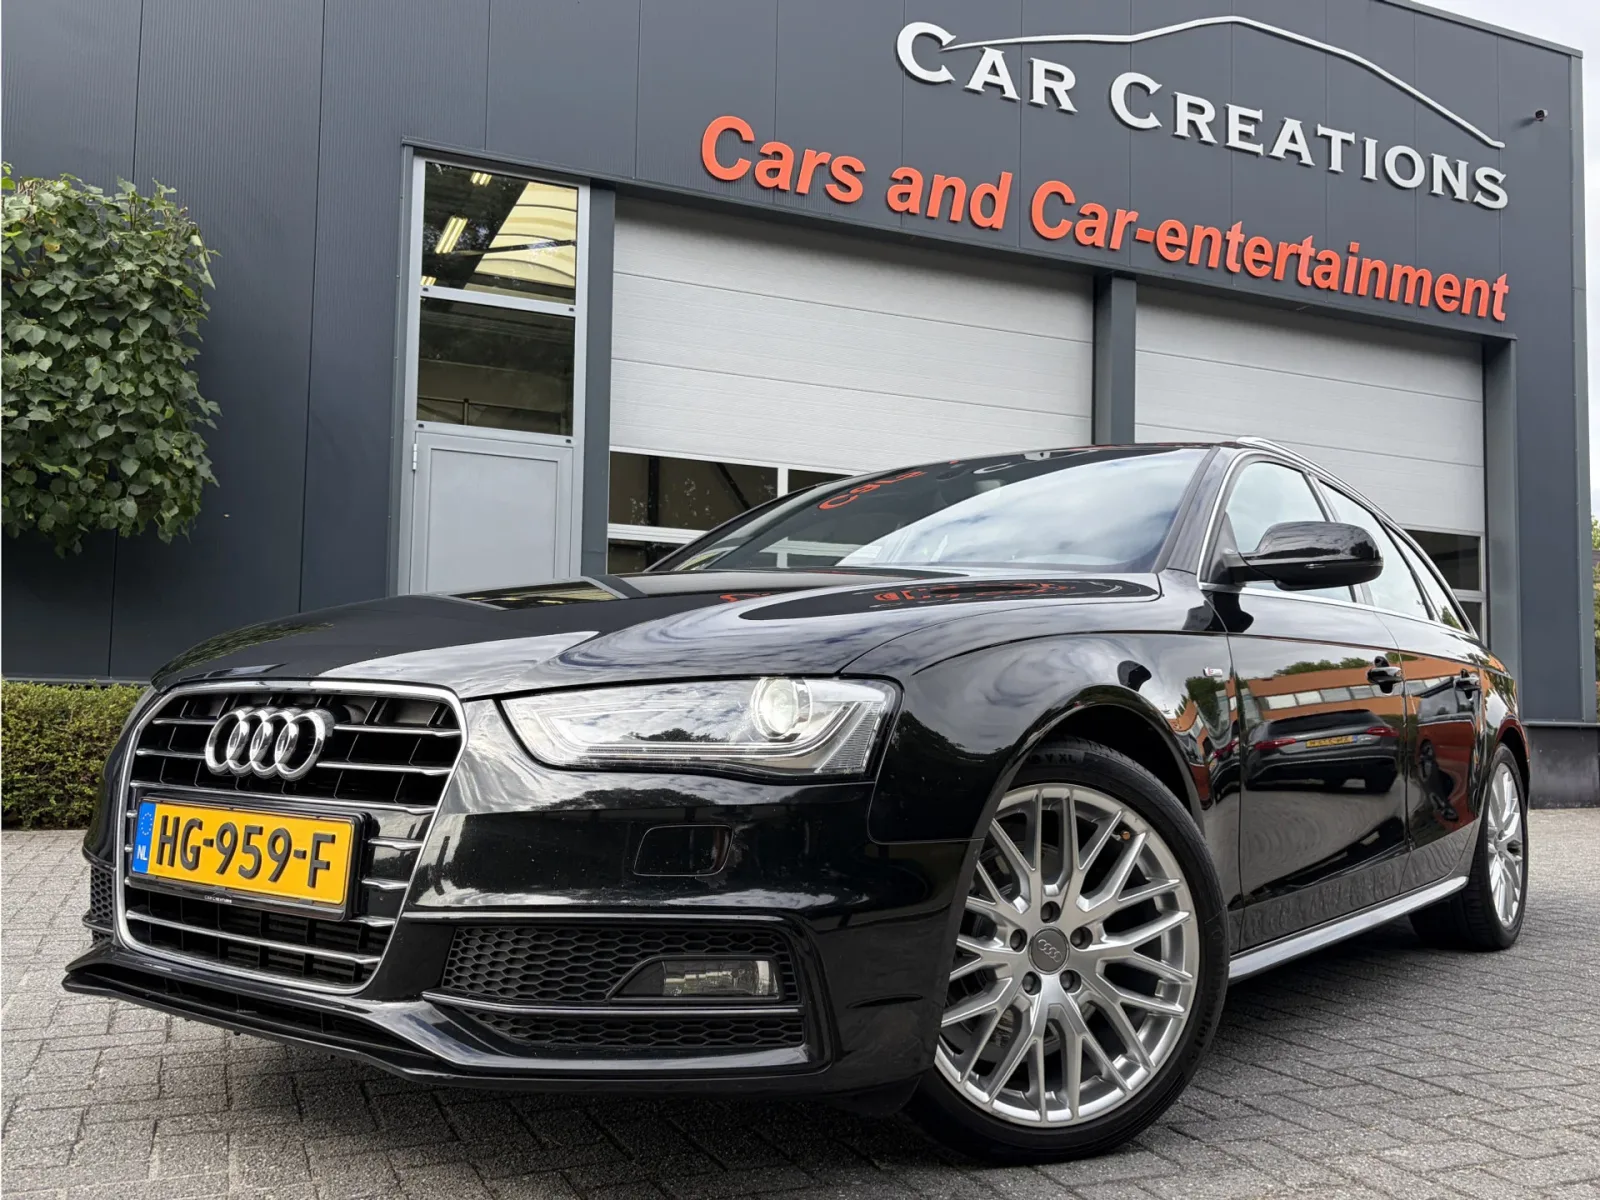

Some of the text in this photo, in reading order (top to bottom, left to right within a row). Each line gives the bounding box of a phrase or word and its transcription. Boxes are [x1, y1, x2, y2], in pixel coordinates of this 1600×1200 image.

[897, 22, 1508, 210] CAR CREATIONS
[702, 116, 1510, 322] Cars and Car-entertainment
[137, 844, 148, 861] NL
[157, 815, 336, 888] HG-959-F
